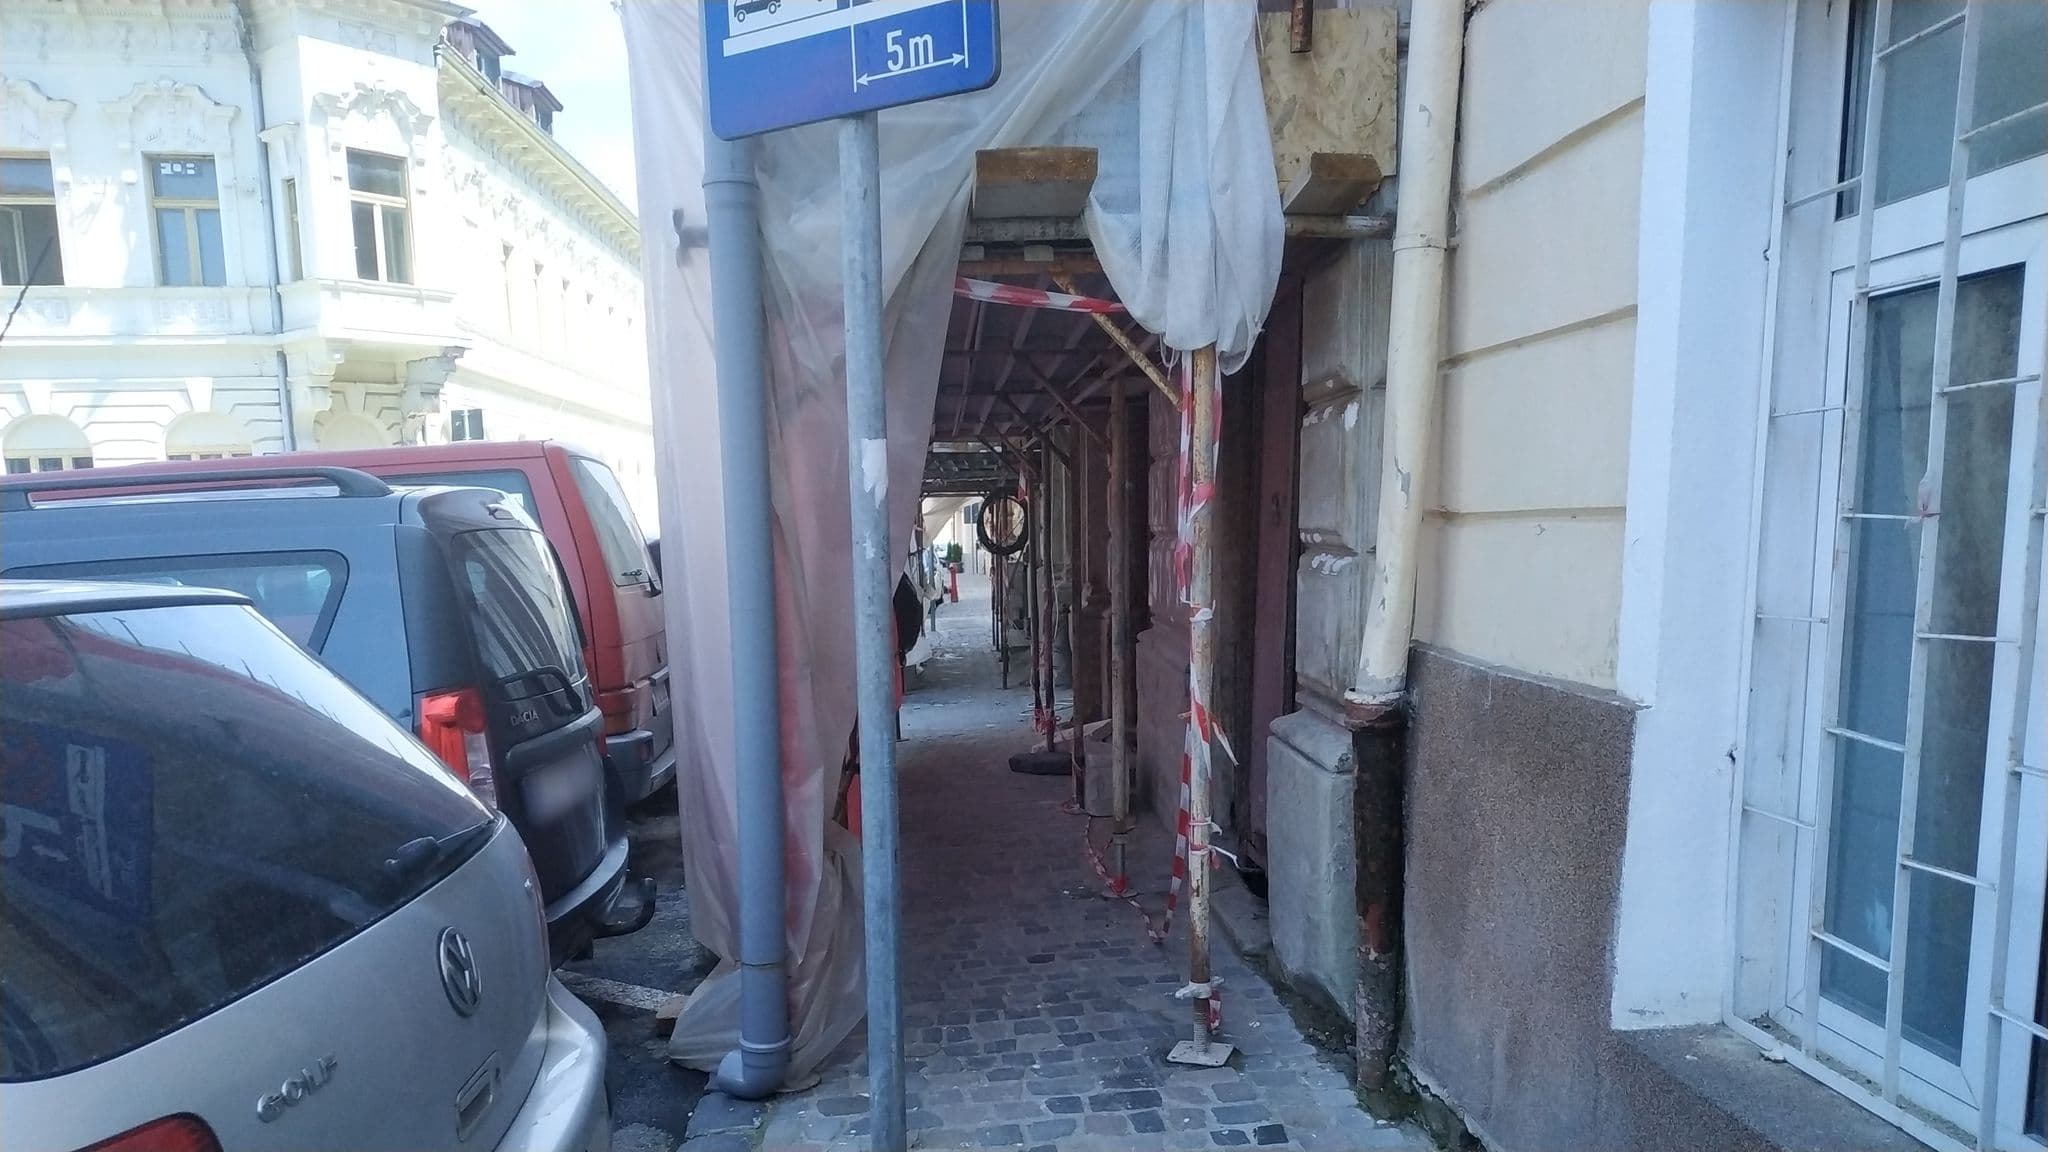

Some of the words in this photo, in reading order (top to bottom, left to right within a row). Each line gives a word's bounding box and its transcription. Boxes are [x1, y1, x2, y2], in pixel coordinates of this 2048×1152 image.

[886, 29, 934, 71] 5m
[510, 709, 540, 727] DACIA
[257, 1055, 338, 1123] GOLF
